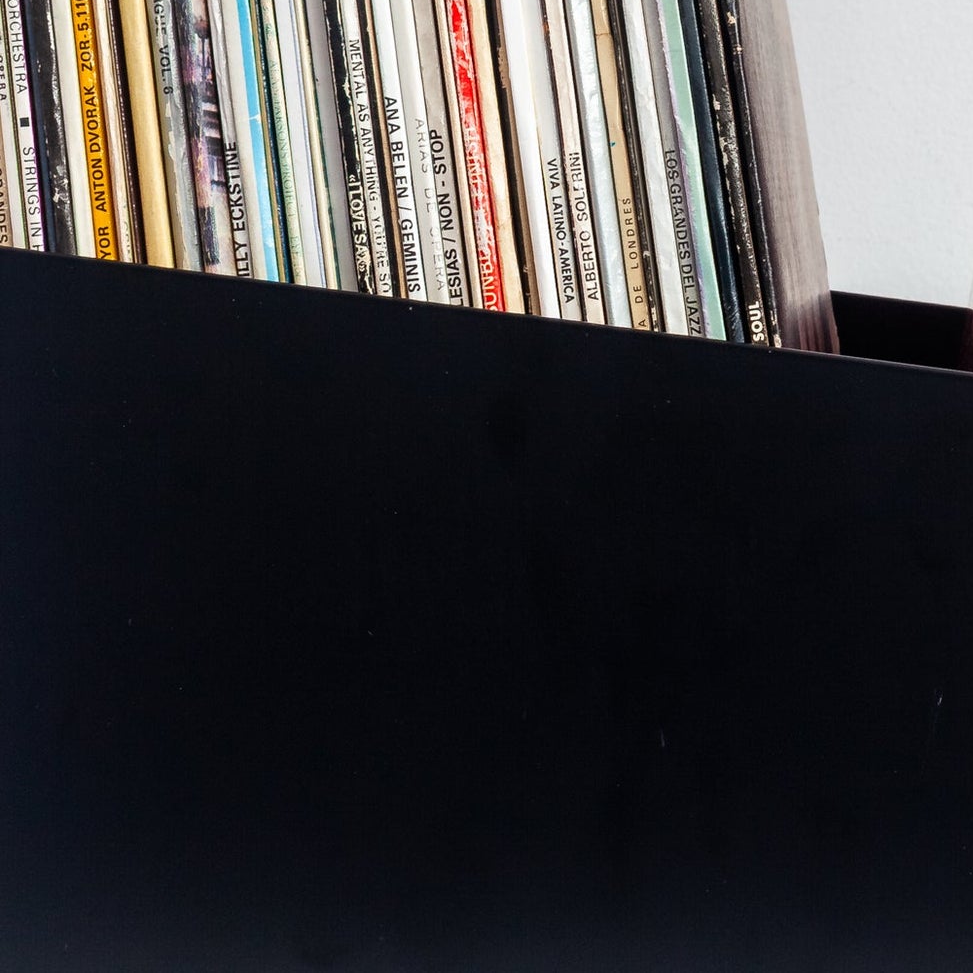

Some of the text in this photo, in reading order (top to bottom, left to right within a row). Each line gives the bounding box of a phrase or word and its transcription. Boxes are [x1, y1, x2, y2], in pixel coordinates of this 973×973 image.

[8, 0, 27, 94] ORCHESTRA
[349, 38, 367, 98] MENTAL
[83, 85, 102, 153] DVORAK
[357, 102, 370, 122] AS
[415, 118, 429, 174] ARIAS
[22, 146, 40, 216] STRINGS
[92, 158, 107, 212] ANTON
[224, 141, 246, 232] ECKSTINE
[360, 126, 379, 202] ANYTHING
[429, 129, 447, 176] STOP
[384, 95, 421, 293] ANA BELEN GEMINIS
[438, 193, 456, 231] NON
[30, 222, 42, 238] IN
[547, 158, 575, 304] VIVA LATINO-AMERICA
[622, 198, 639, 270] LONDRES
[665, 150, 701, 335] LOS GRANDES DEL JAZZ
[579, 230, 599, 301] ALBERTO
[635, 284, 644, 304] DE
[749, 301, 764, 342] SOUL
